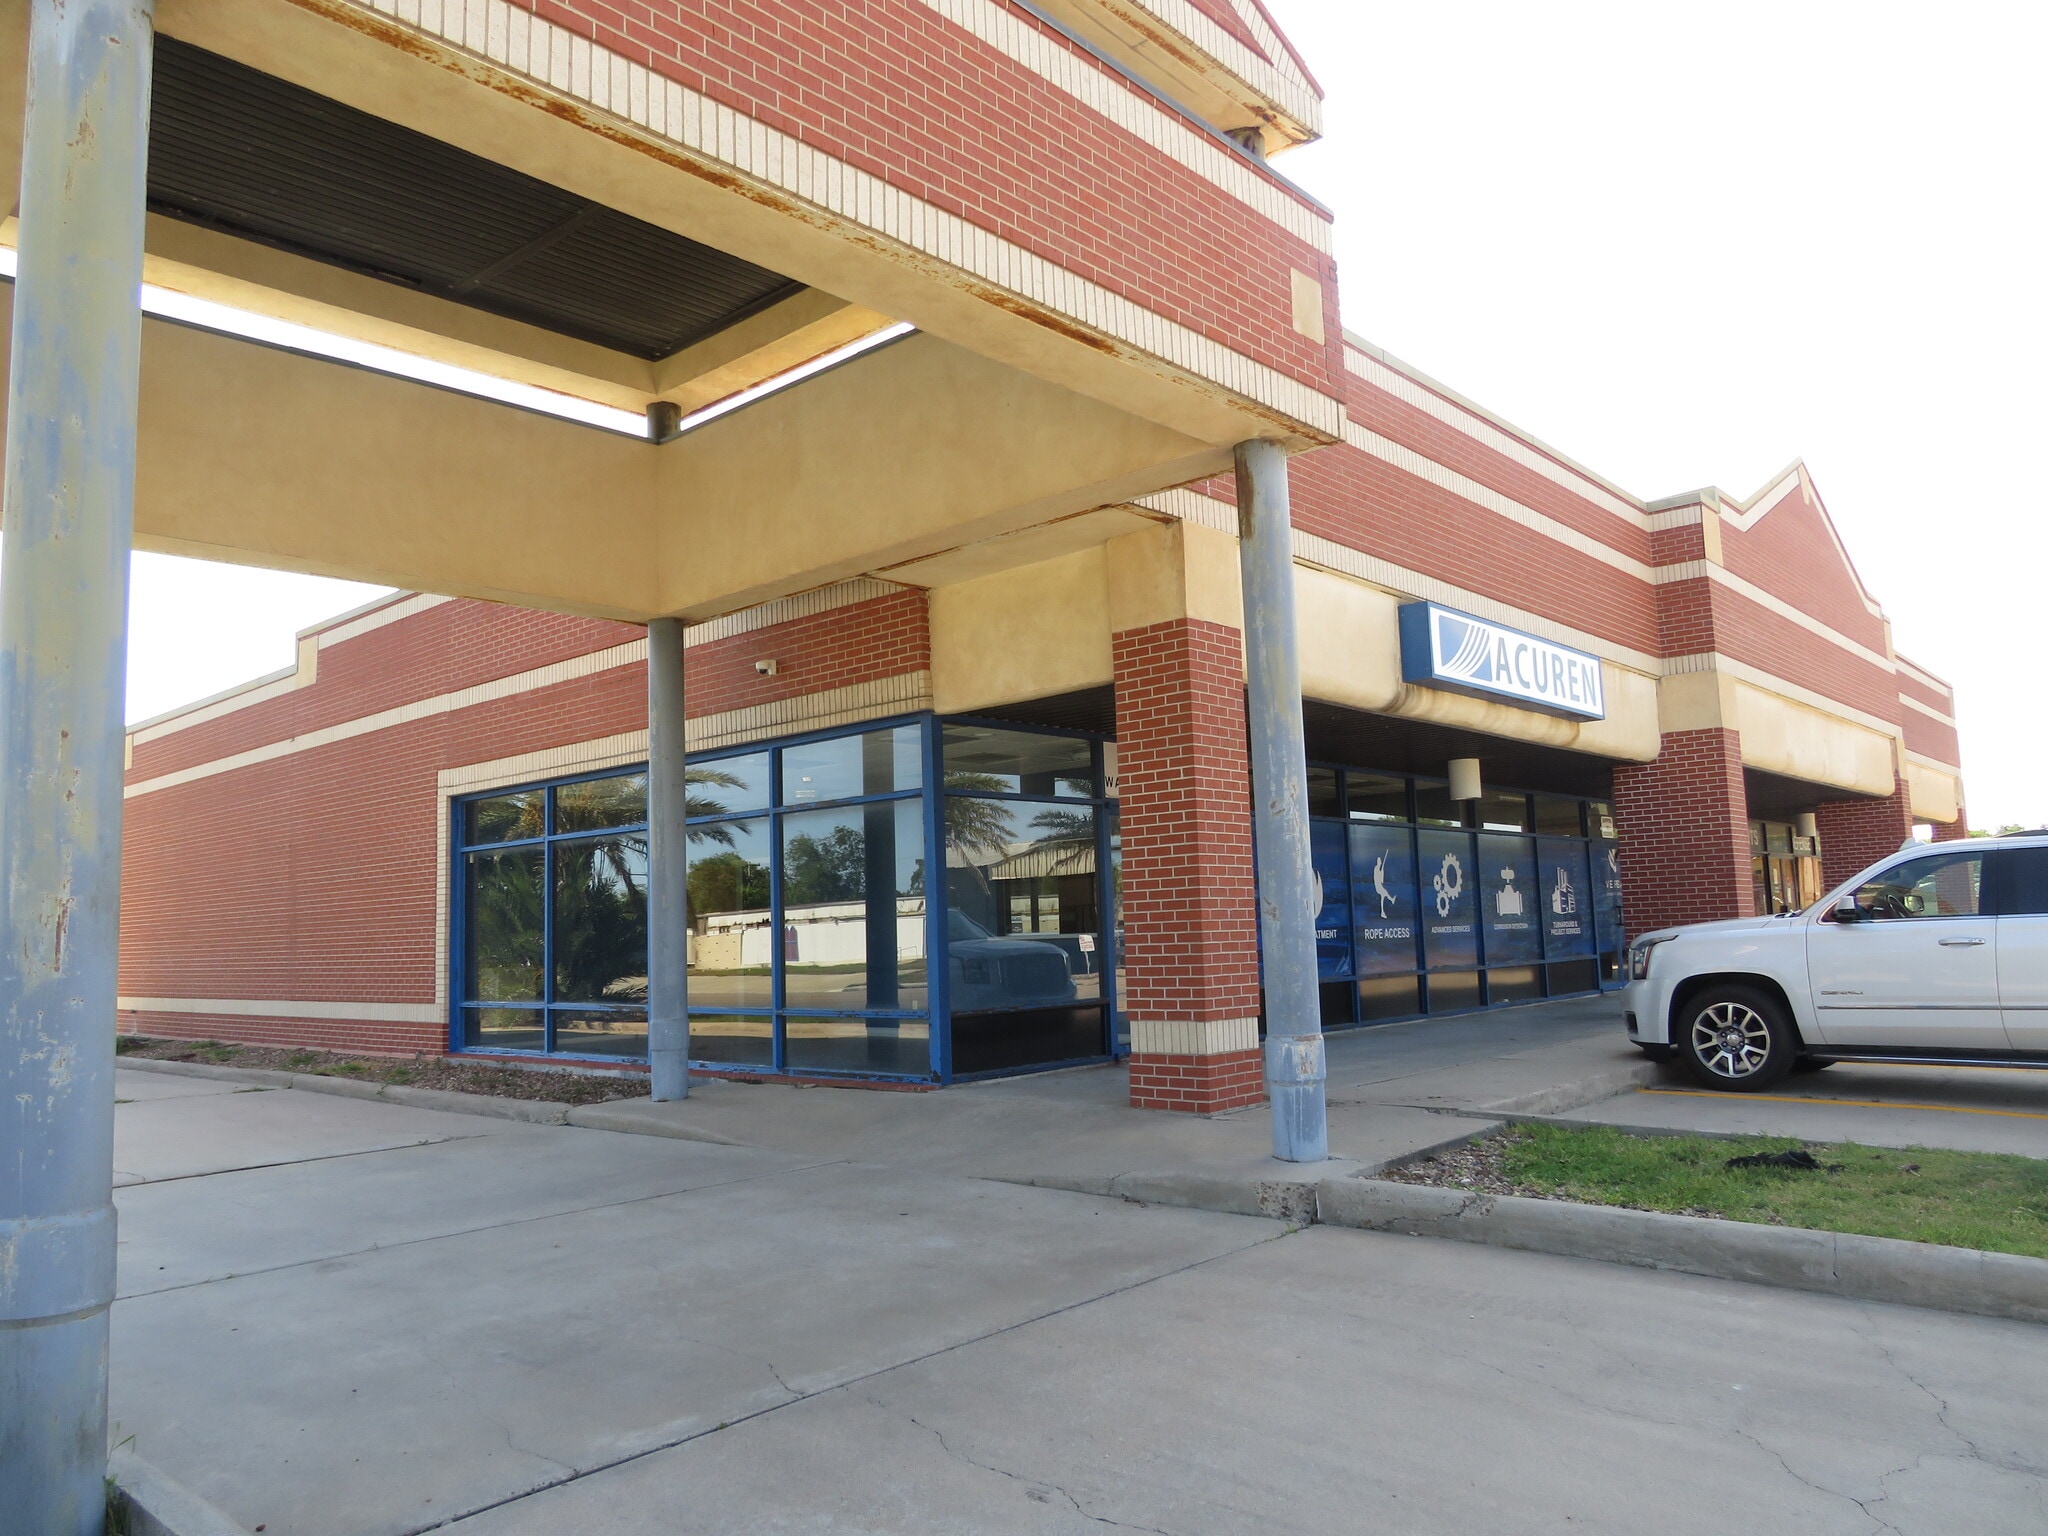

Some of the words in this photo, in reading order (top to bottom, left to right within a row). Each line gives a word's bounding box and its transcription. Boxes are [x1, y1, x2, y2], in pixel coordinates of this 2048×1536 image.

[1495, 637, 1597, 707] ACUREN
[1364, 928, 1384, 940] ROPE
[1384, 927, 1410, 939] ACCESS
